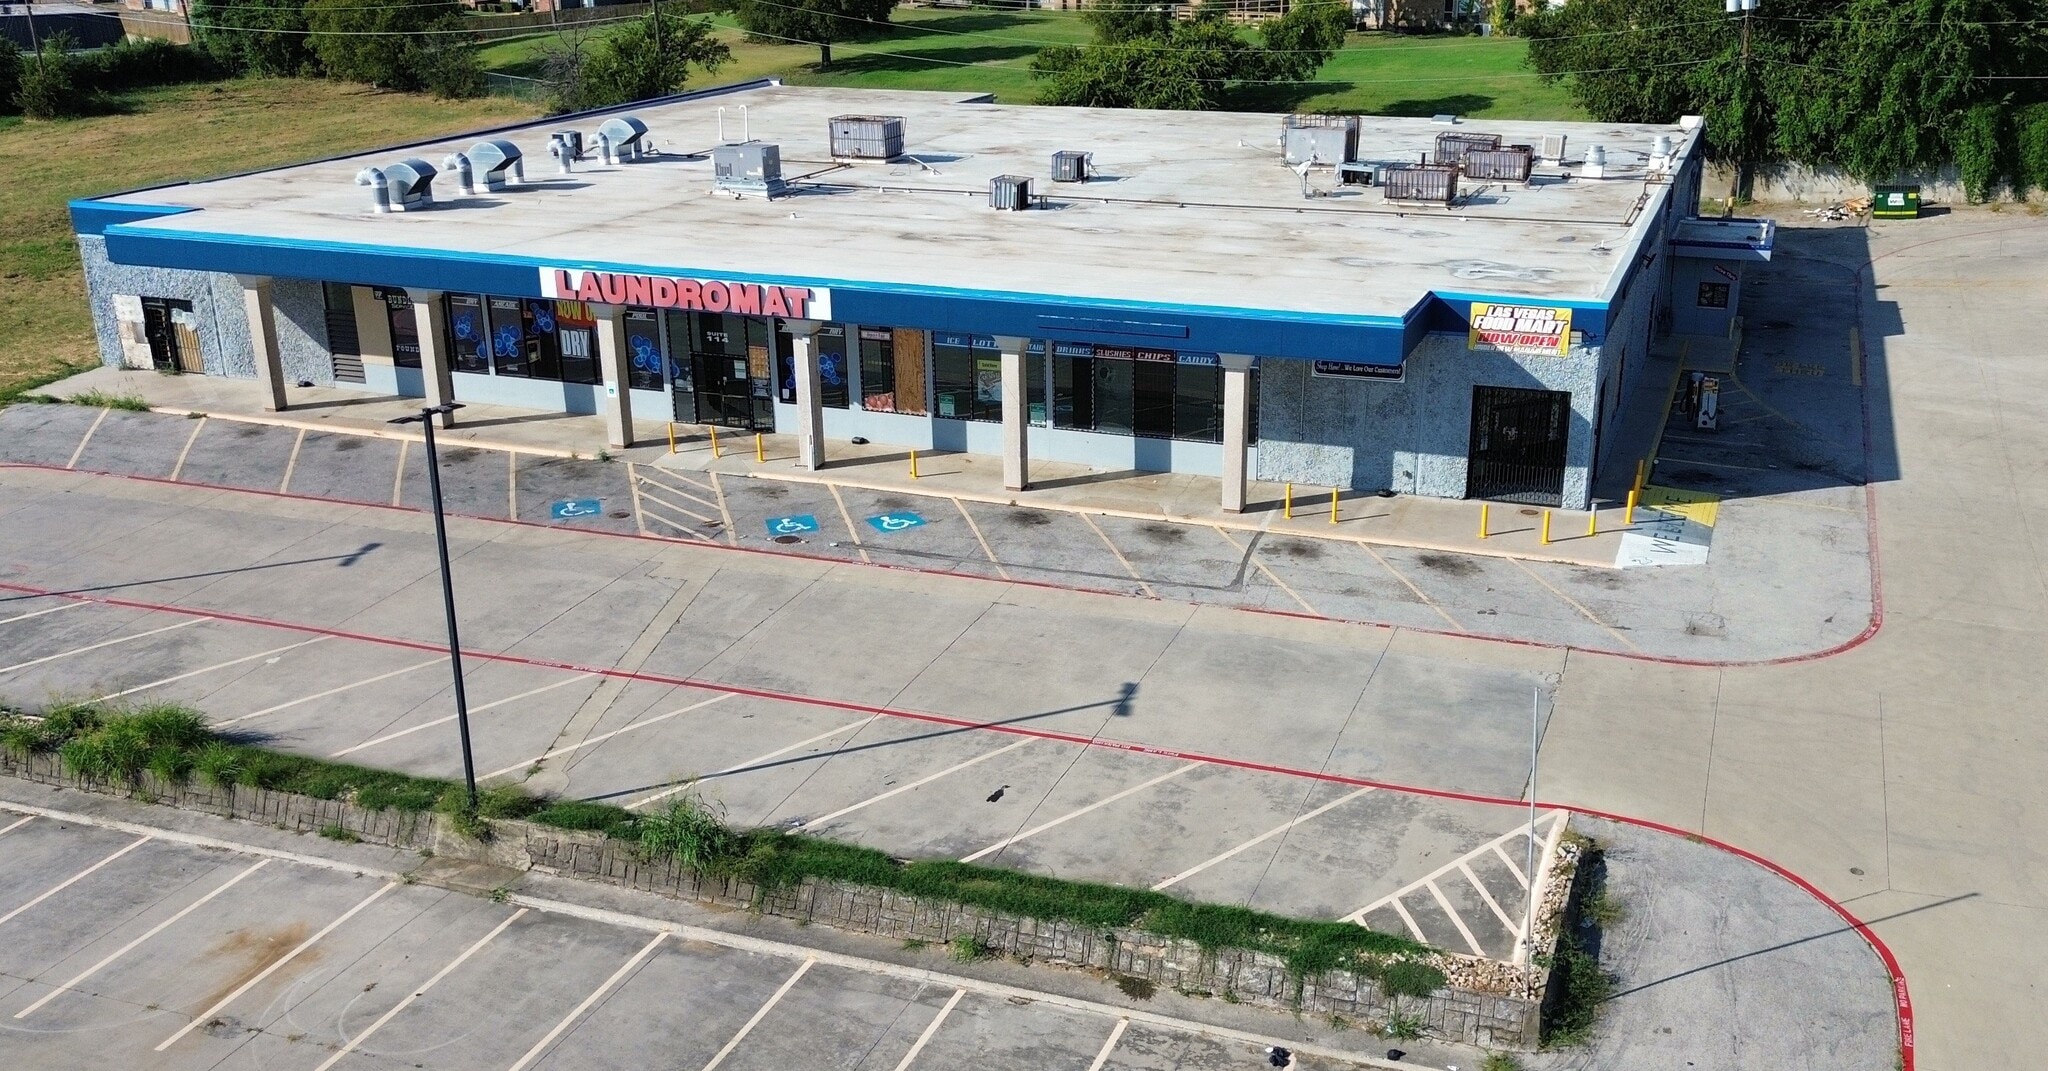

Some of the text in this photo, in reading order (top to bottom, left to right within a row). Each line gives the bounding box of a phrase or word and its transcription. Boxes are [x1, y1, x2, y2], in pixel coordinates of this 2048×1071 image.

[555, 269, 814, 319] LAUNDROMAT
[1486, 306, 1555, 321] LAS VEGAS
[1473, 316, 1568, 335] FOOD MART
[561, 328, 590, 358] DRY
[1478, 333, 1559, 347] NOW OPEN
[1056, 345, 1091, 355] DRINKS
[1096, 349, 1132, 359] SLUSHIES
[1137, 352, 1171, 361] CHIPS
[1178, 355, 1215, 364] CANDY
